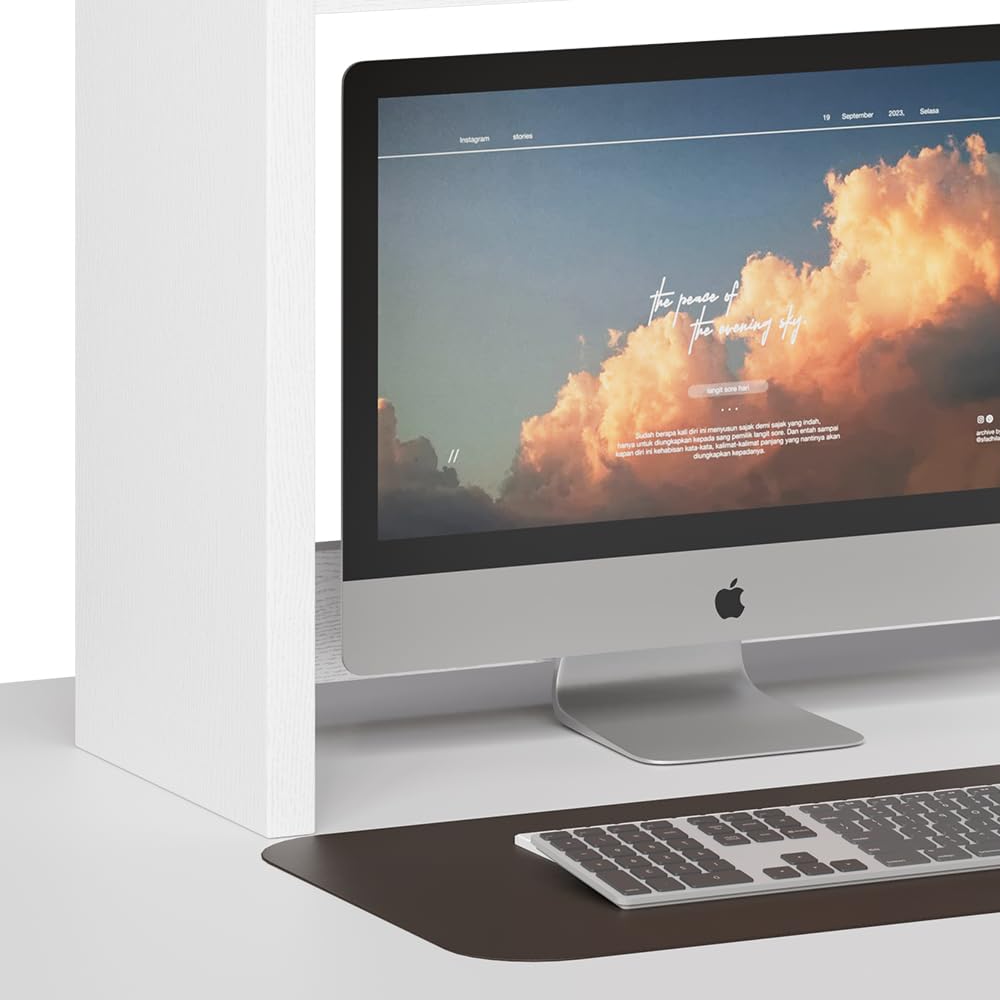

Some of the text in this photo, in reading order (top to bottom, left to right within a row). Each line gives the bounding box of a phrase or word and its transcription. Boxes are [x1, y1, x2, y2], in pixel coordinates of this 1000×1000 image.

[842, 112, 874, 120] September
[459, 136, 490, 144] Instagram
[648, 276, 740, 328] the peace of
[688, 305, 715, 355] the
[719, 317, 773, 346] evening
[655, 430, 676, 438] berapa
[771, 421, 787, 429] sajak
